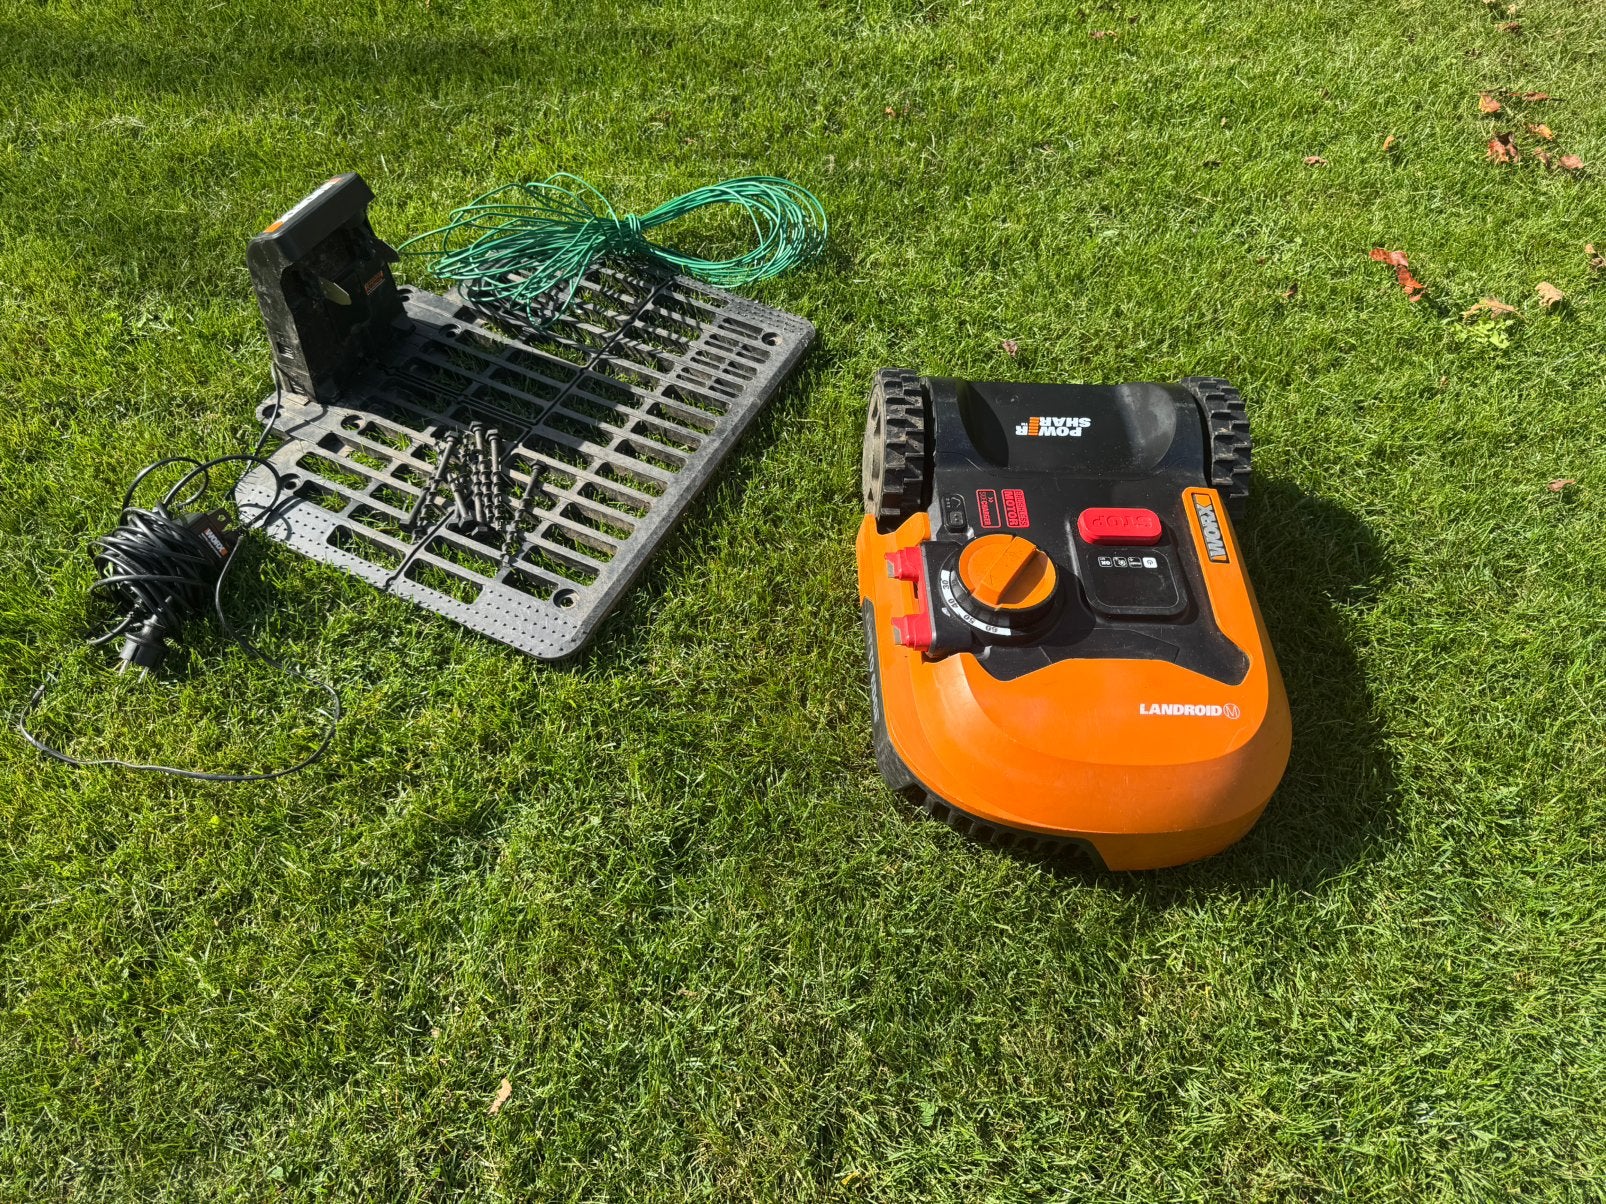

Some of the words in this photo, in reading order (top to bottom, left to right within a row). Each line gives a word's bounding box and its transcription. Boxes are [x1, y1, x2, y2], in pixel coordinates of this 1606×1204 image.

[1003, 490, 1019, 526] MOTOR
[1014, 490, 1028, 527] BRUSHLESS
[1092, 515, 1153, 528] STOP
[1196, 503, 1226, 557] WORX
[204, 528, 225, 551] WORX
[942, 580, 950, 590] 30
[947, 598, 958, 608] 40
[963, 614, 975, 624] 50
[985, 625, 998, 633] 60
[1139, 703, 1222, 716] LANDROID
